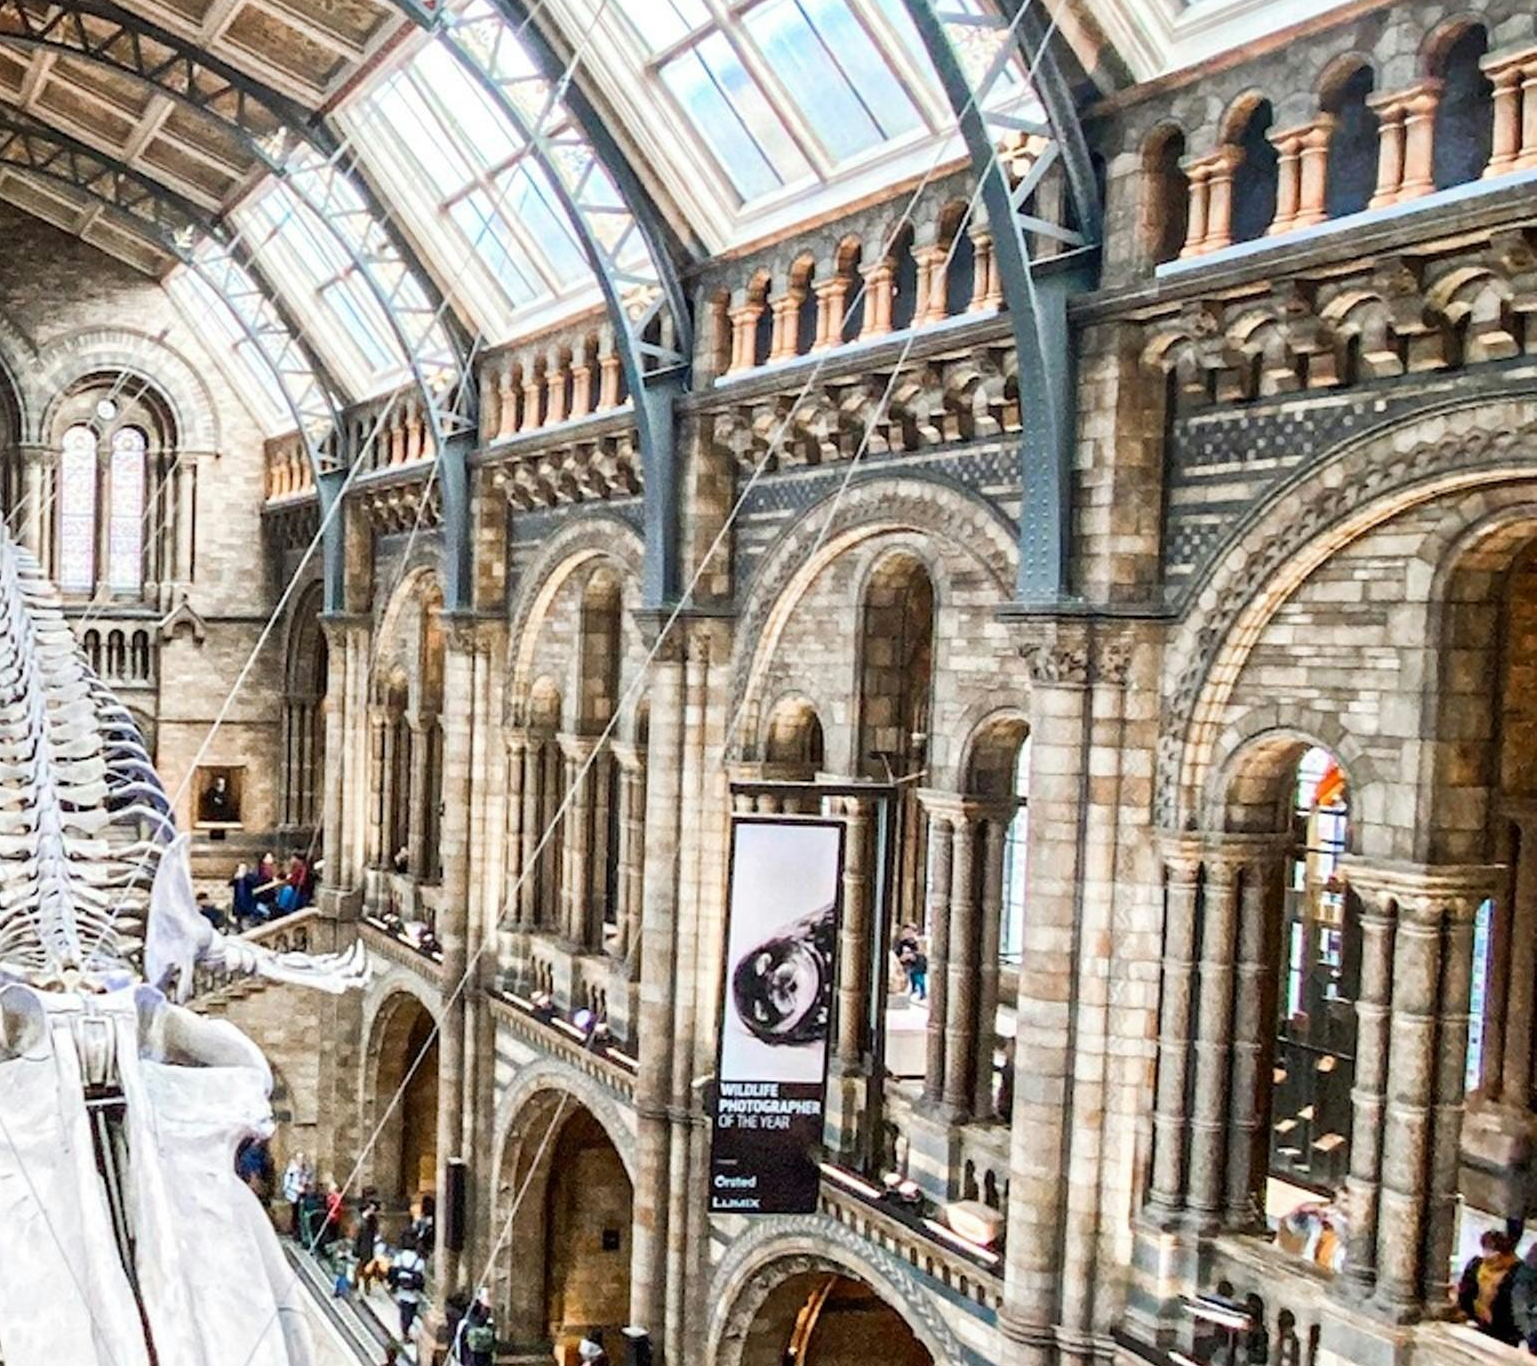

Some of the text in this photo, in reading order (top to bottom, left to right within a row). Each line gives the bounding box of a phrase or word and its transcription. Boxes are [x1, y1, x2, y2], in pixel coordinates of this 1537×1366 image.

[720, 1082, 779, 1097] WILDLIFE
[718, 1099, 821, 1114] PHOTOGRAPHER
[717, 1115, 790, 1128] OF THE YEAR
